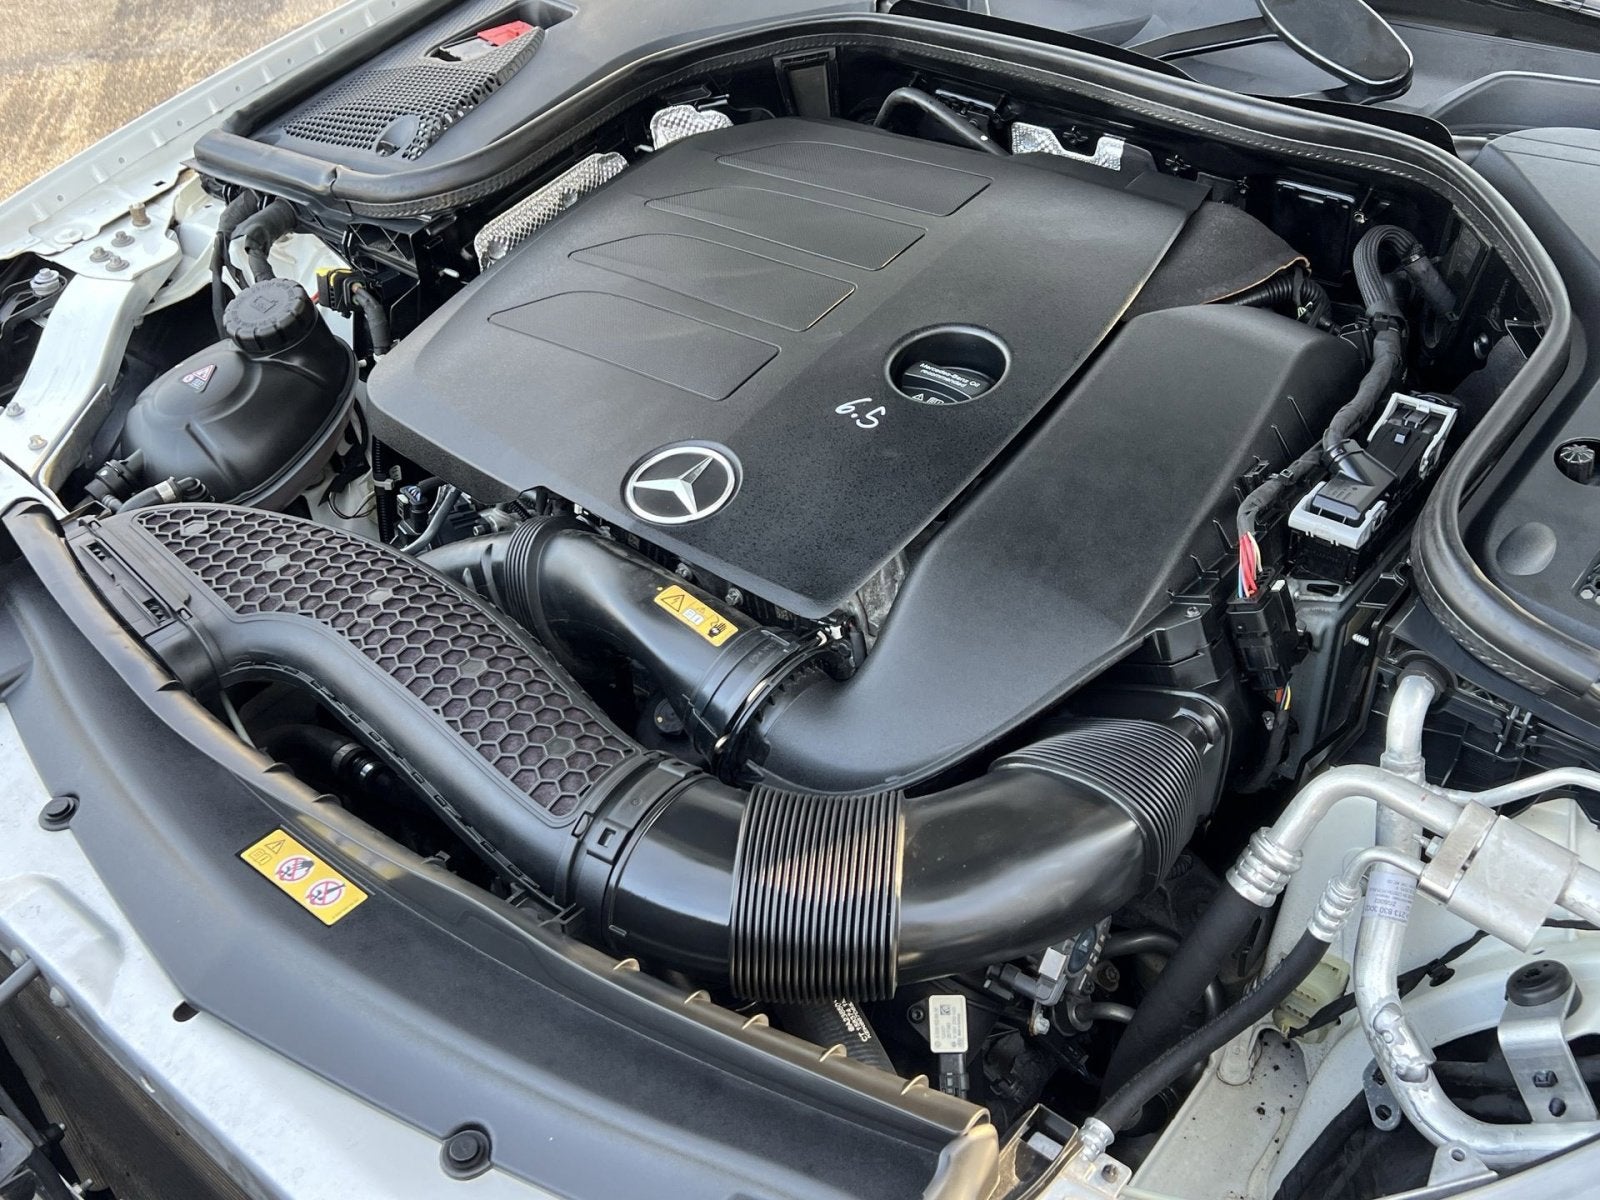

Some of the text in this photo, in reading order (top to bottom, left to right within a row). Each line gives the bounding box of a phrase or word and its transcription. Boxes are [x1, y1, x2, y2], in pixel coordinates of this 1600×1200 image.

[919, 363, 969, 383] Mercedes-Benz
[920, 369, 968, 388] recommended
[835, 397, 887, 429] 6.5
